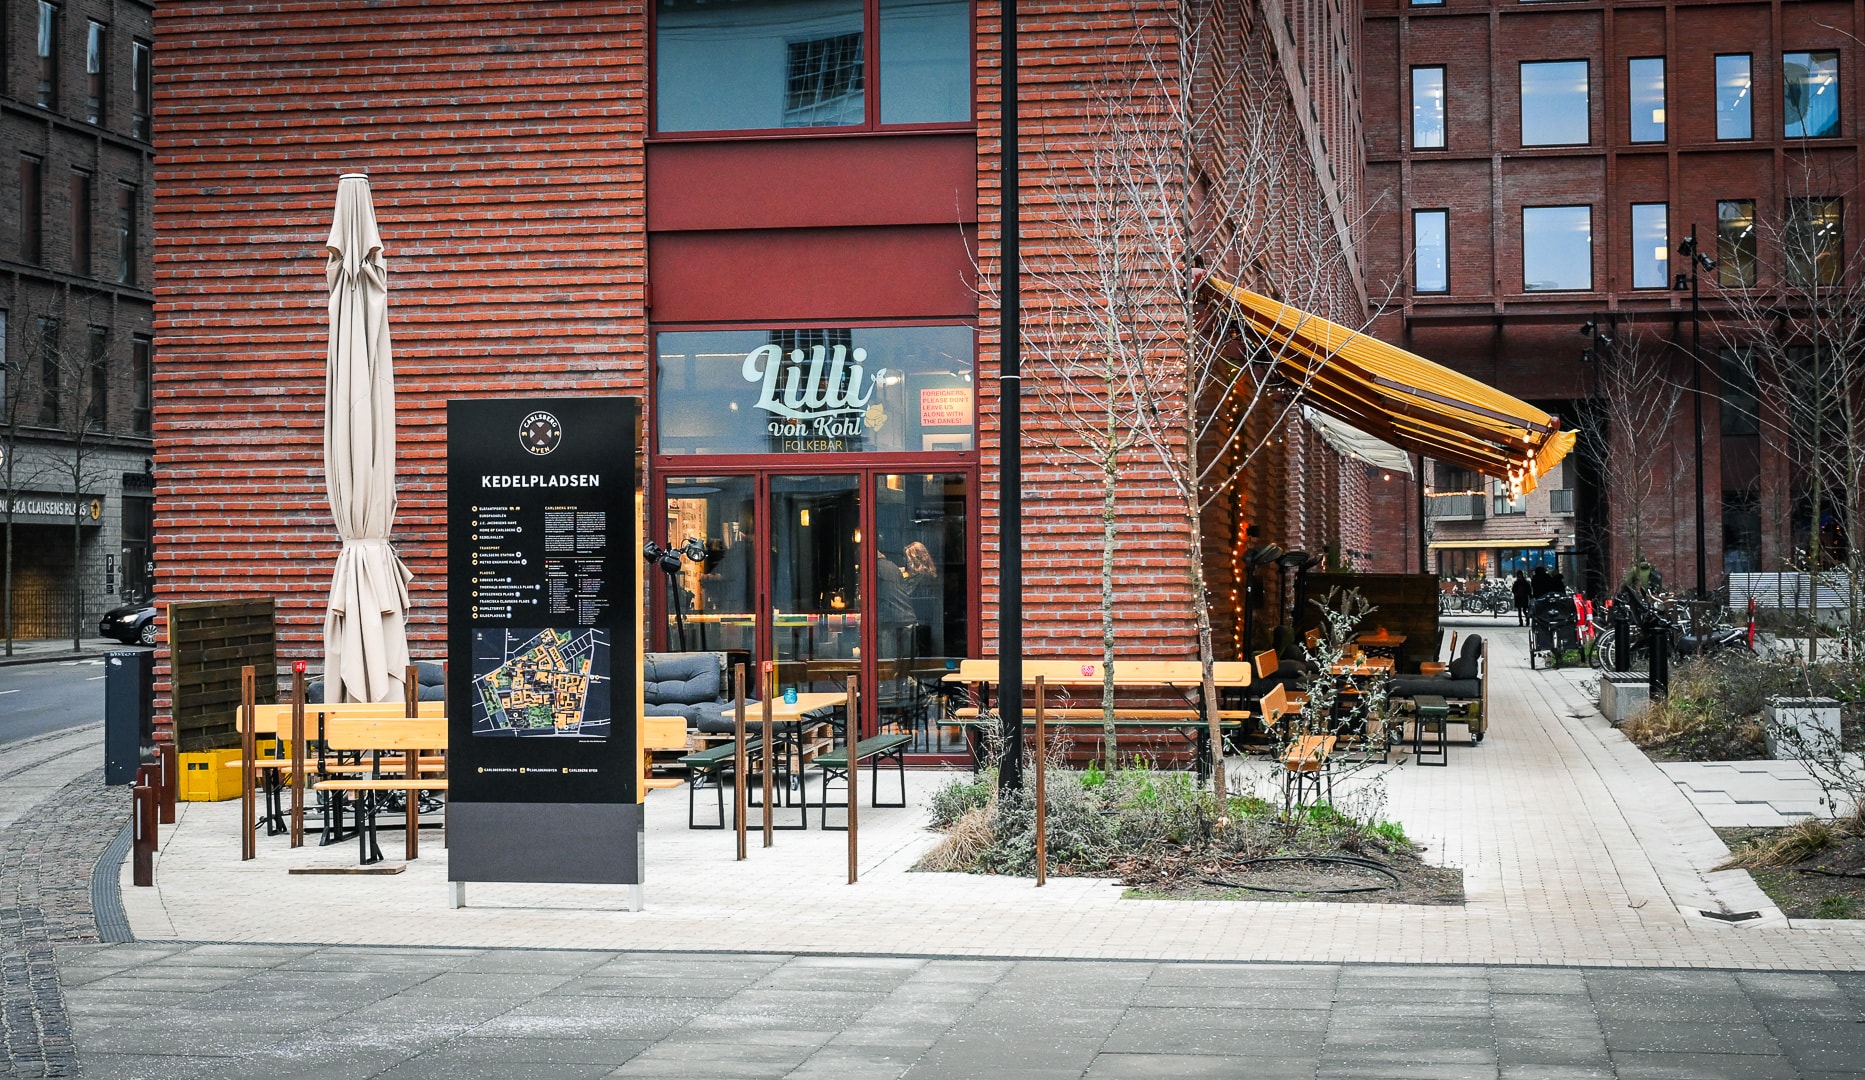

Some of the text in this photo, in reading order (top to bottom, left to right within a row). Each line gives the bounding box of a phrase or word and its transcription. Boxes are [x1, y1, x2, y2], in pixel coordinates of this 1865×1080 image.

[741, 343, 887, 419] Lilli
[523, 414, 558, 428] CARLSBERG
[767, 417, 862, 438] von Kohl
[530, 445, 550, 454] BYEN
[785, 440, 843, 451] FOLKEBAR
[481, 474, 600, 488] KEDELPLADSEN
[27, 500, 64, 515] CLAUSENS
